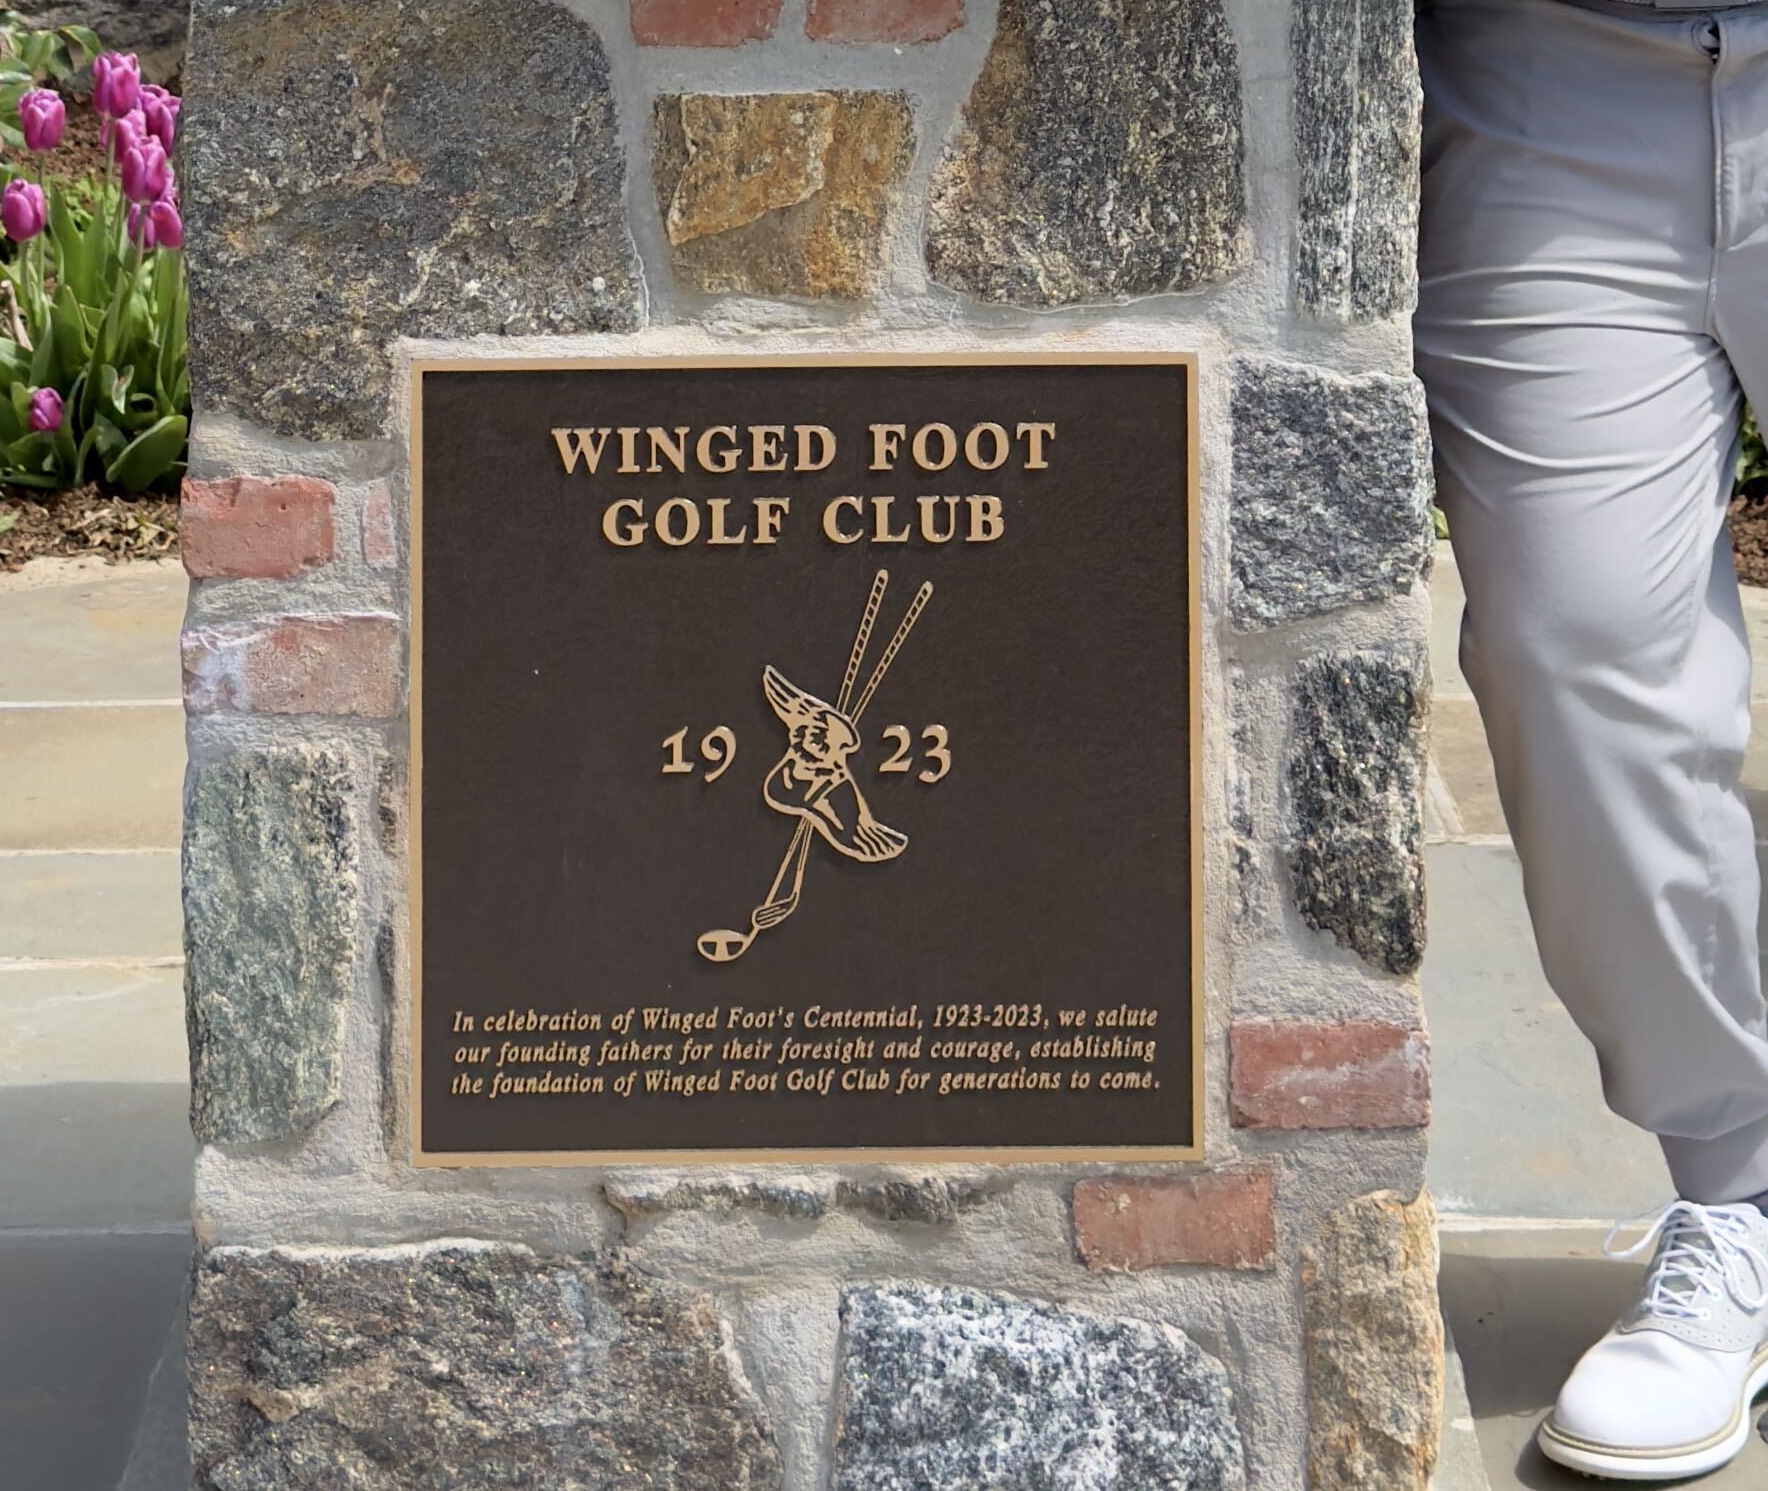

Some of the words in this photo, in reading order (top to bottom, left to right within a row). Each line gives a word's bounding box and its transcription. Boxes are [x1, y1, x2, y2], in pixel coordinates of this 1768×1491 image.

[550, 423, 838, 476] WINGED
[868, 421, 1057, 472] FOOT
[602, 496, 791, 547] GOLF
[822, 494, 1006, 545] CLUB
[661, 725, 738, 783] 19
[878, 724, 953, 784] 23
[452, 1011, 474, 1032] In
[483, 1009, 602, 1032] celebration
[611, 1008, 635, 1035] of
[642, 1007, 719, 1034] Winged
[727, 1007, 794, 1029] Foot's
[803, 1005, 923, 1030] Centennial,
[933, 1004, 1049, 1030] 1923-2023,
[1059, 1008, 1087, 1027] we
[1095, 1006, 1157, 1027] salute
[455, 1045, 490, 1063] our
[496, 1041, 591, 1067] founding
[597, 1039, 672, 1066] fathers
[679, 1038, 713, 1065] for
[721, 1038, 772, 1060] their
[777, 1037, 874, 1064] foresight
[883, 1036, 922, 1059] and
[931, 1040, 1021, 1062] courage,
[1030, 1035, 1156, 1063] establishing
[451, 1072, 483, 1094] the
[489, 1070, 604, 1098] foundation
[613, 1071, 637, 1097] of
[644, 1069, 721, 1096] Winged
[729, 1070, 777, 1092] Foot
[787, 1068, 835, 1094] Golf
[841, 1069, 890, 1090] Club
[896, 1068, 930, 1094] for
[939, 1066, 1061, 1094] generations
[1070, 1070, 1090, 1089] to
[1099, 1070, 1161, 1089] come.
